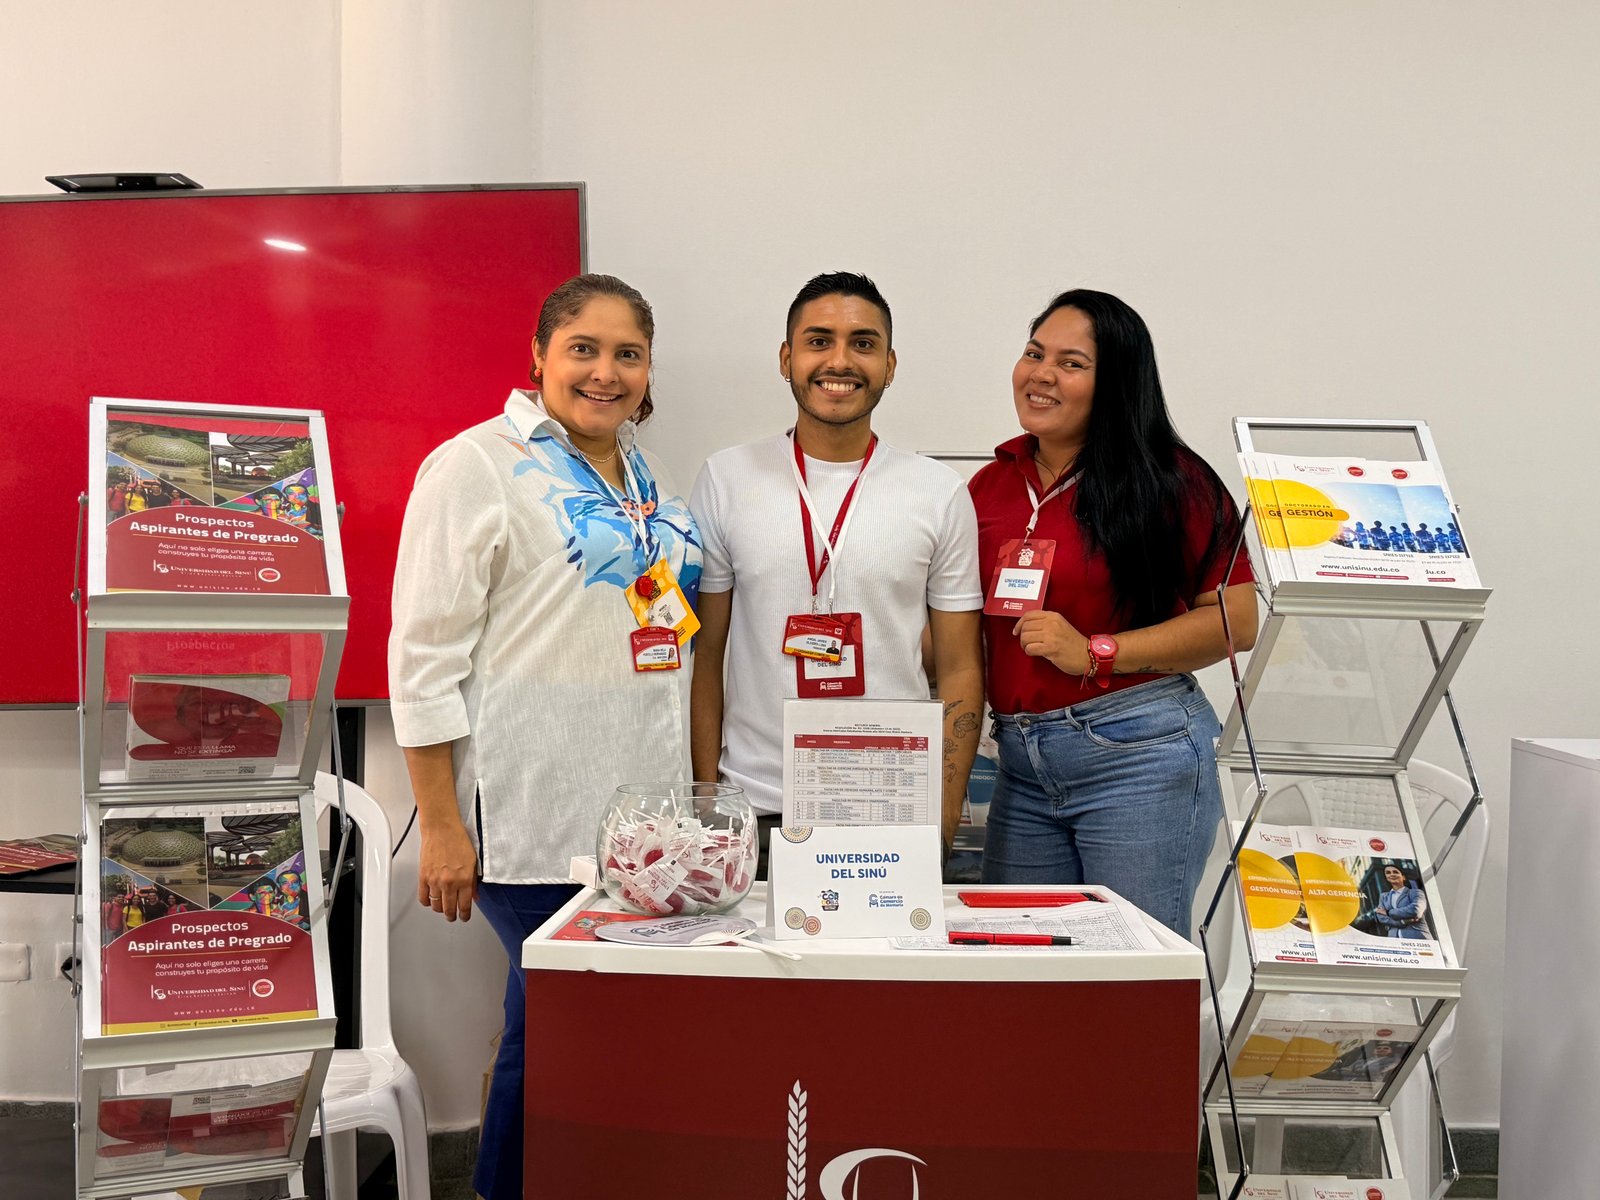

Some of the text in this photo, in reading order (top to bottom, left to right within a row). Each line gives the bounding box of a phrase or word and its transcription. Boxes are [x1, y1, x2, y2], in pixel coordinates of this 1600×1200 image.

[1286, 508, 1333, 518] GESTIÓN
[175, 512, 255, 529] Prospectos
[130, 521, 299, 543] Aspirantes de Pregrado
[158, 542, 176, 550] Aquí
[207, 546, 229, 555] eliges
[157, 549, 200, 558] construyes
[210, 552, 247, 560] propósito
[1320, 563, 1400, 573] www.unisinu.edu.co
[816, 853, 900, 864] UNIVERSIDAD
[831, 866, 887, 879] DEL SINÚ
[1250, 885, 1280, 894] GESTIÓN
[1308, 889, 1367, 899] ALTA GERENCIA
[171, 921, 249, 935] Prospectos
[128, 933, 292, 953] Aspirantes de Pregrado
[1341, 953, 1420, 964] www.unisinu.edu.co
[155, 962, 173, 970] Aquí
[203, 960, 225, 968] eliges
[155, 969, 196, 977] construyes
[205, 966, 240, 975] propósito
[174, 1006, 255, 1016] www.unisinu.edu.co
